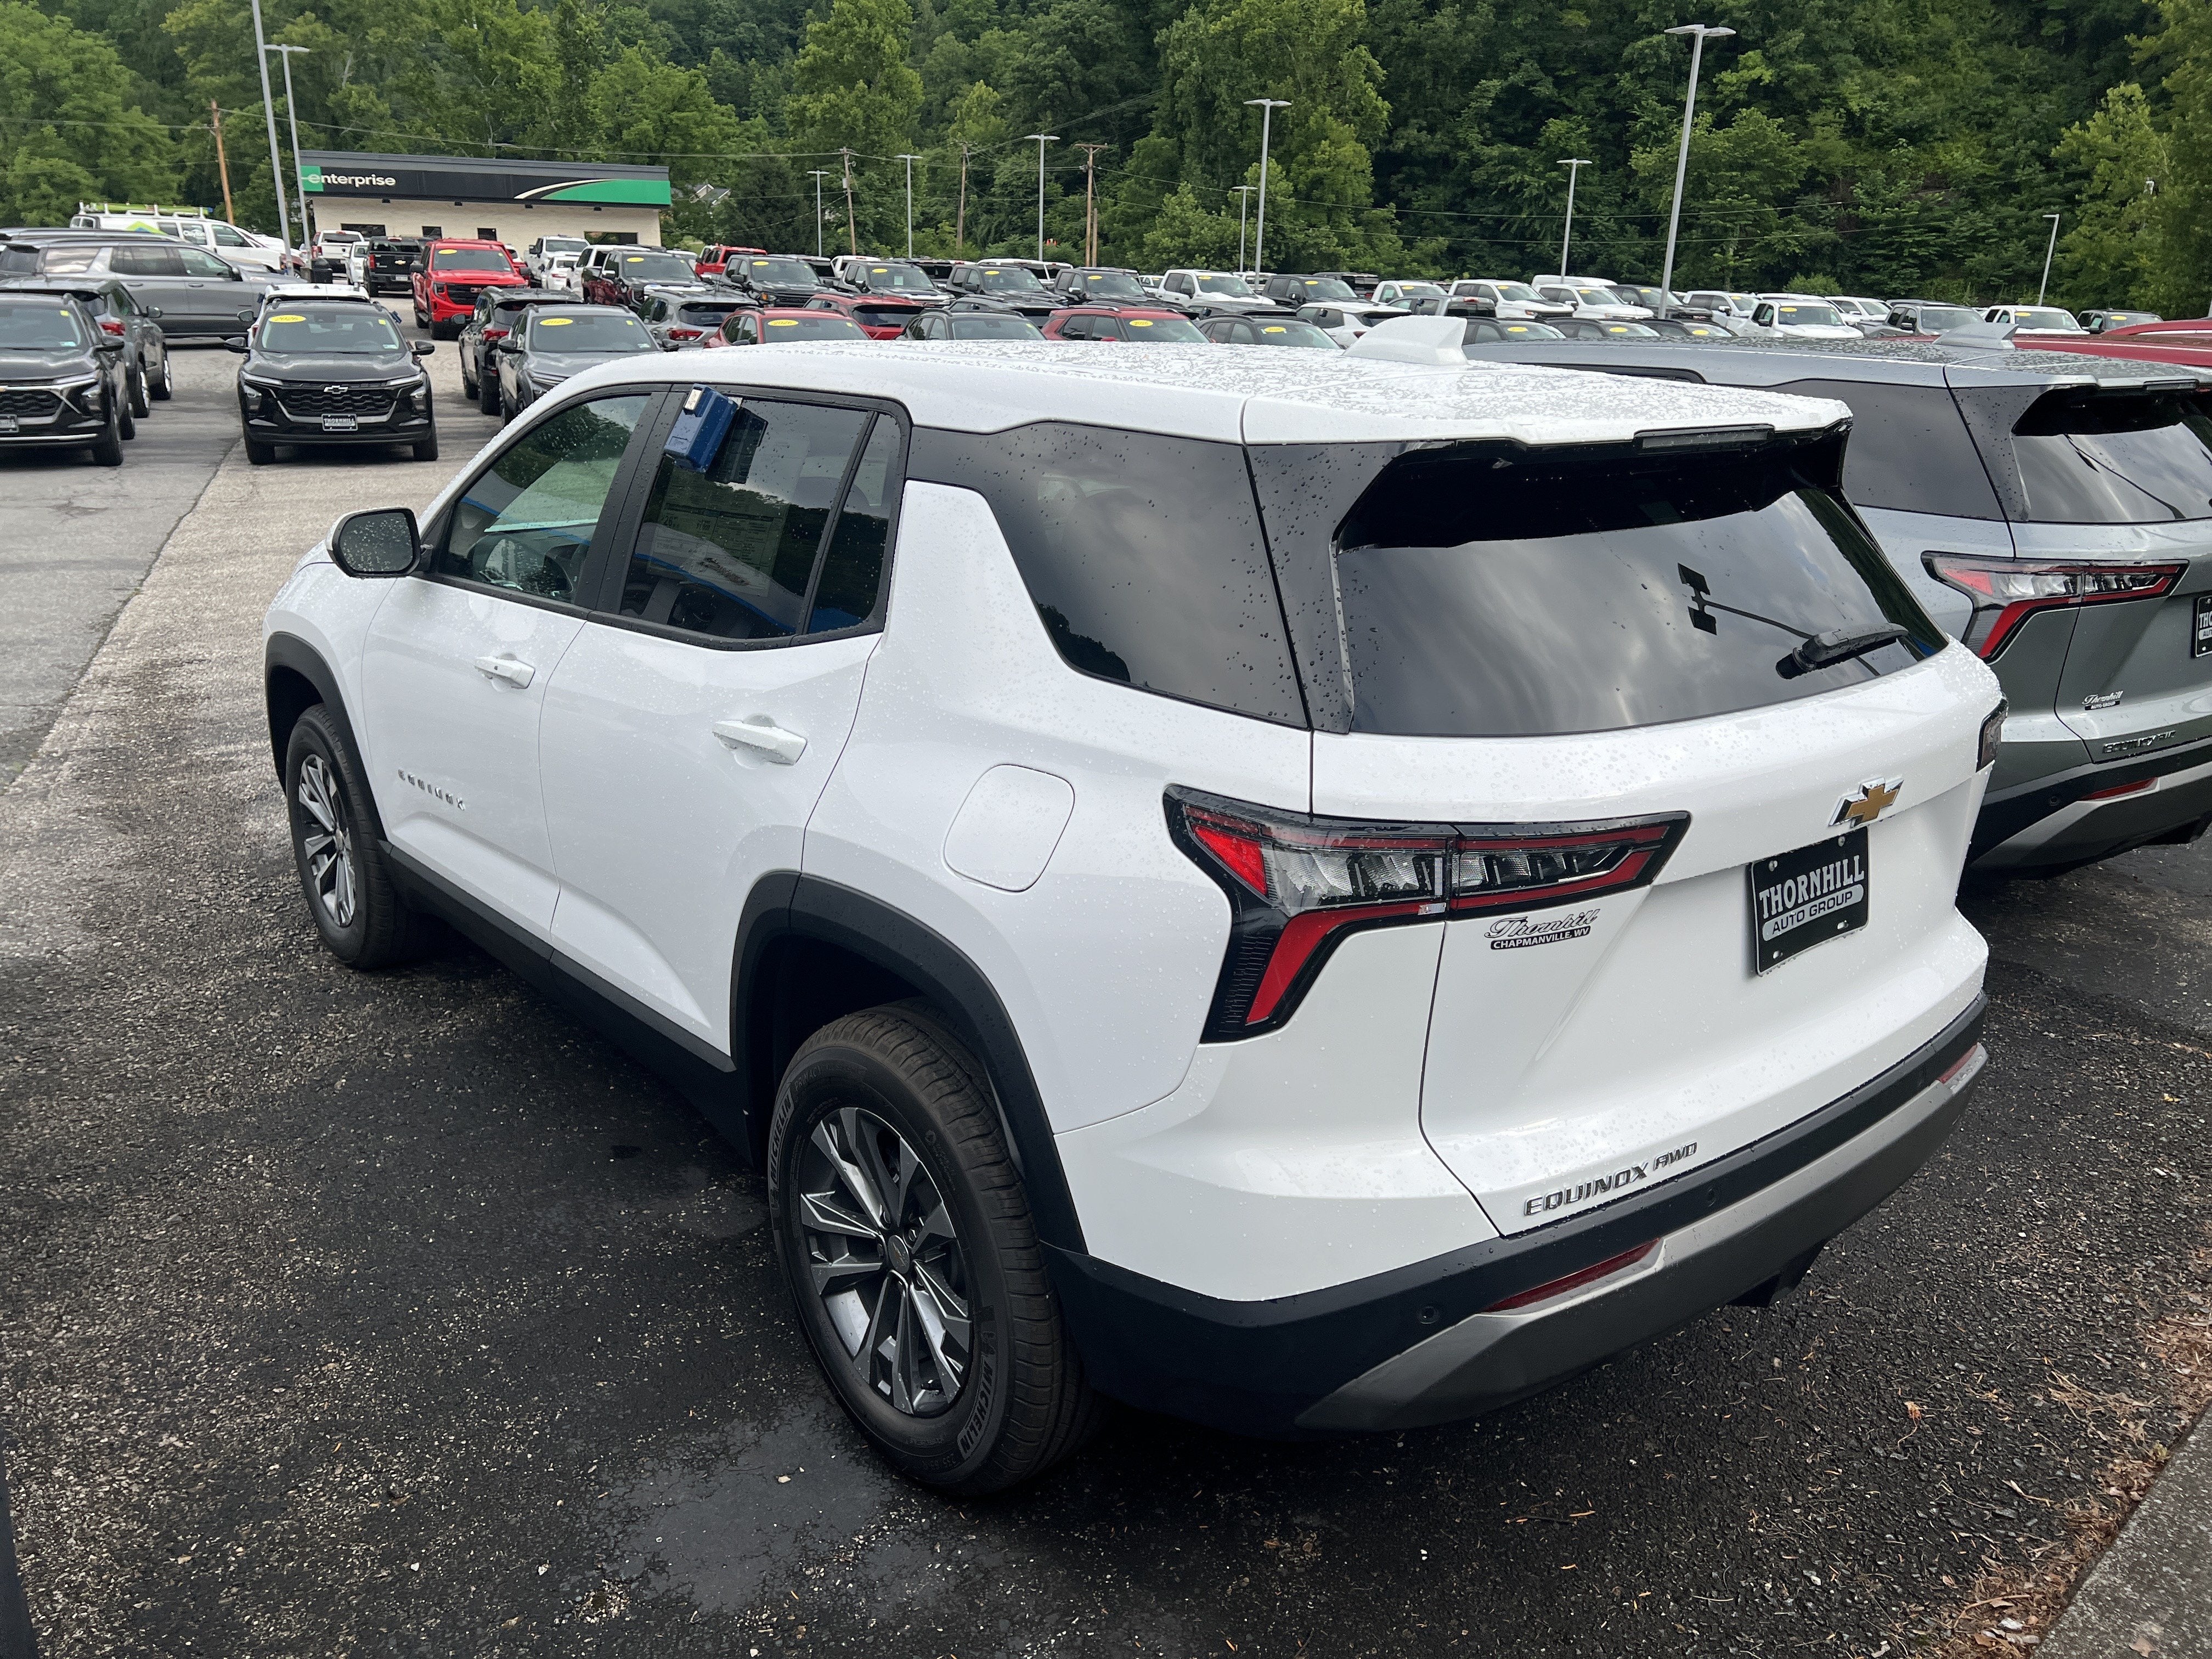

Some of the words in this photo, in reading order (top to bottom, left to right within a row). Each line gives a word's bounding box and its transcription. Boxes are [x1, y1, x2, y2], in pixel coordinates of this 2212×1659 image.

[308, 173, 396, 188] enterprise
[1759, 855, 1865, 919] THORNHILL
[1771, 909, 1805, 935] AUTO
[1809, 890, 1853, 918] GROUP
[1483, 909, 1601, 938] Thornhill
[1493, 932, 1572, 949] CHAPMANVILLE,
[1573, 927, 1590, 937] WV
[770, 1093, 792, 1186] MICHELIN
[1523, 1161, 1649, 1216] EQUINOX
[1652, 1140, 1698, 1171] AWD
[960, 1359, 994, 1454] MICHELIN
